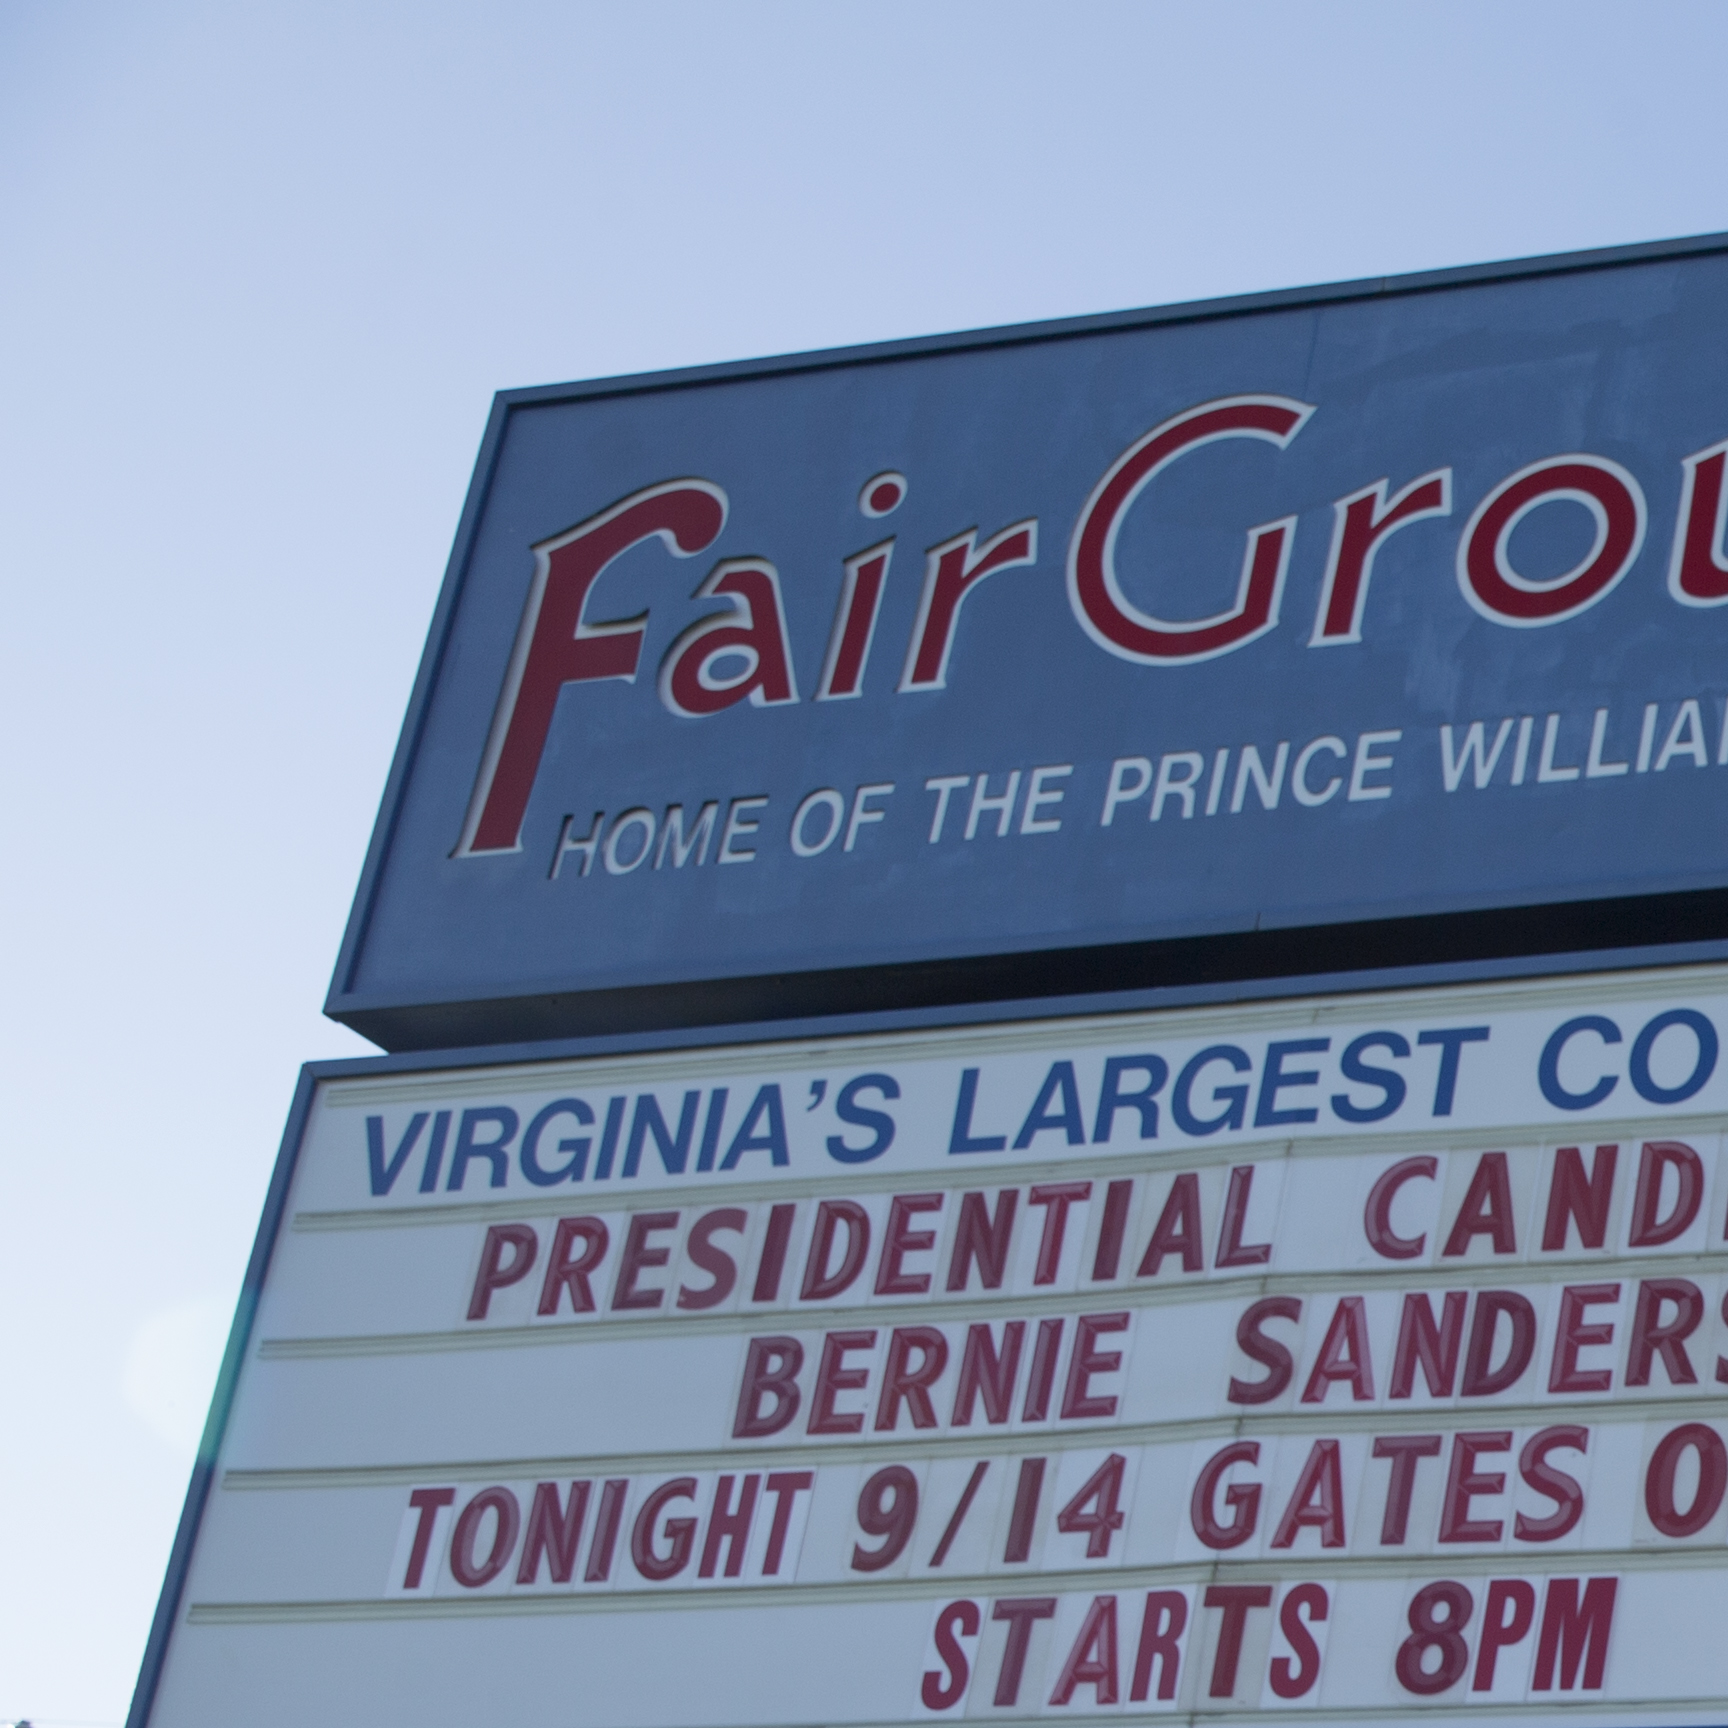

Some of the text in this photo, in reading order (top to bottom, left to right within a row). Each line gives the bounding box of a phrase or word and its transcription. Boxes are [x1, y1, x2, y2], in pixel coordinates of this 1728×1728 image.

[549, 797, 768, 880] HOME
[789, 782, 896, 860] OF
[924, 764, 1073, 844] THE
[1100, 731, 1401, 826] PRINCE
[364, 1074, 902, 1198] VIRGINIA'S
[947, 1025, 1490, 1154] LARGEST
[466, 1166, 1274, 1321] PRESIDENTIAL
[731, 1311, 1131, 1439] BERNIE
[403, 1470, 814, 1590] TONIGHT
[850, 1452, 1127, 1573] 9/14
[1191, 1425, 1590, 1552] GATES
[920, 1576, 1619, 1711] STARTS 8PM
